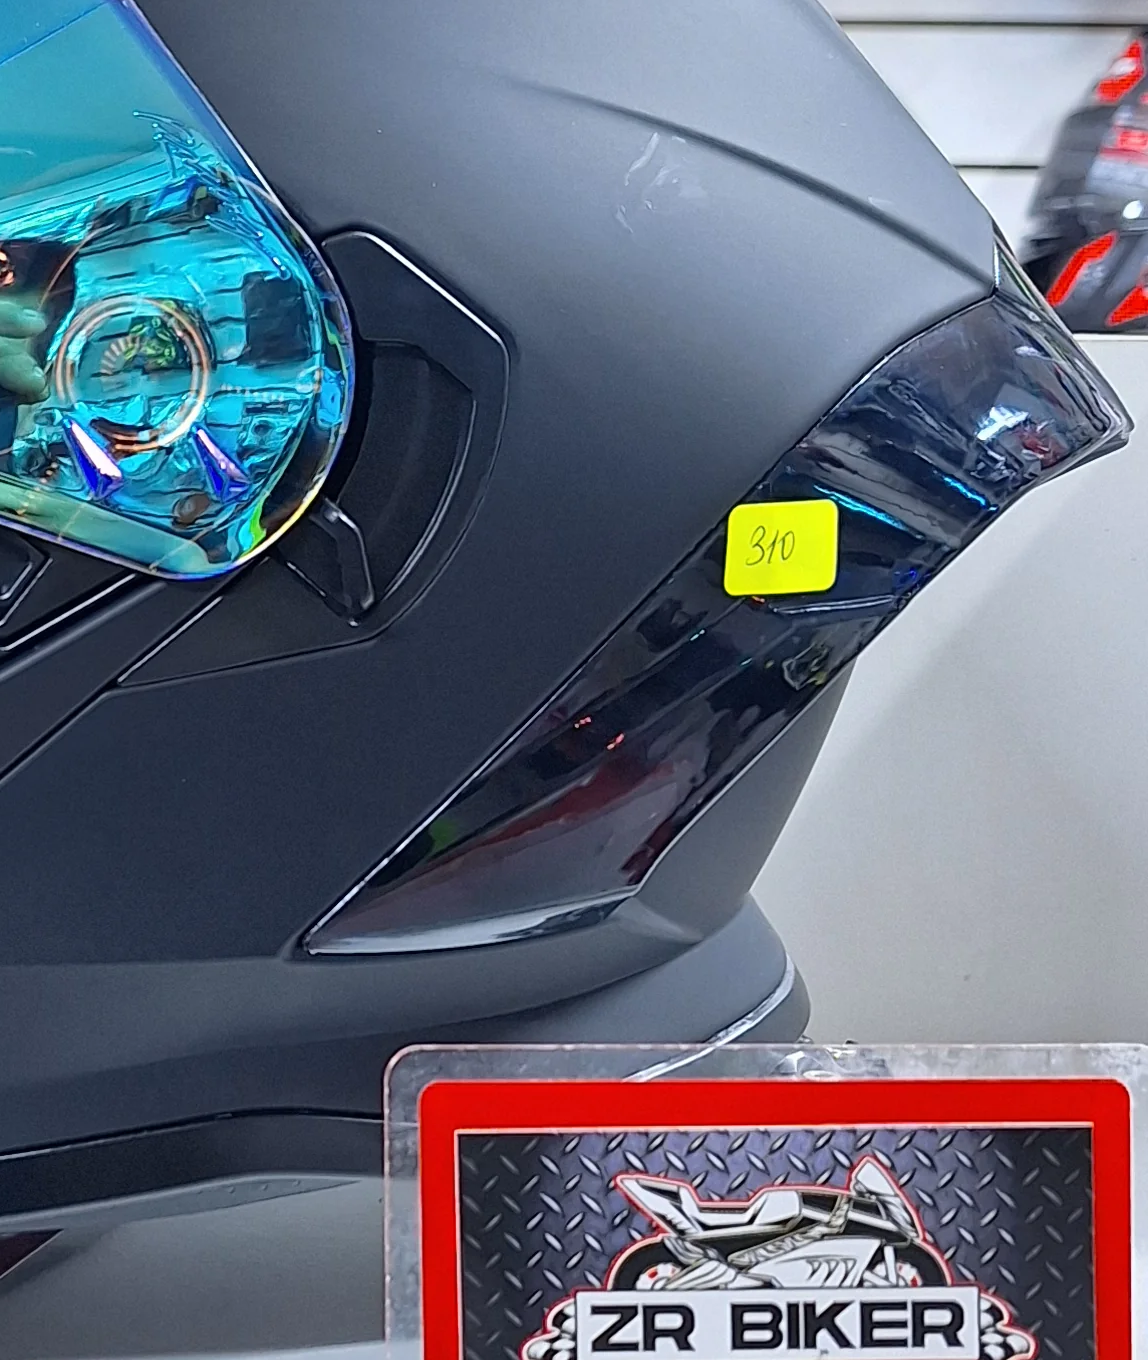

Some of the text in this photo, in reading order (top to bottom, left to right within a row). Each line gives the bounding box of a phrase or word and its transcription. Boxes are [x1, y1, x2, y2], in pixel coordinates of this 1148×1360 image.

[745, 525, 795, 566] 310
[590, 1300, 966, 1352] ZR BIKER
